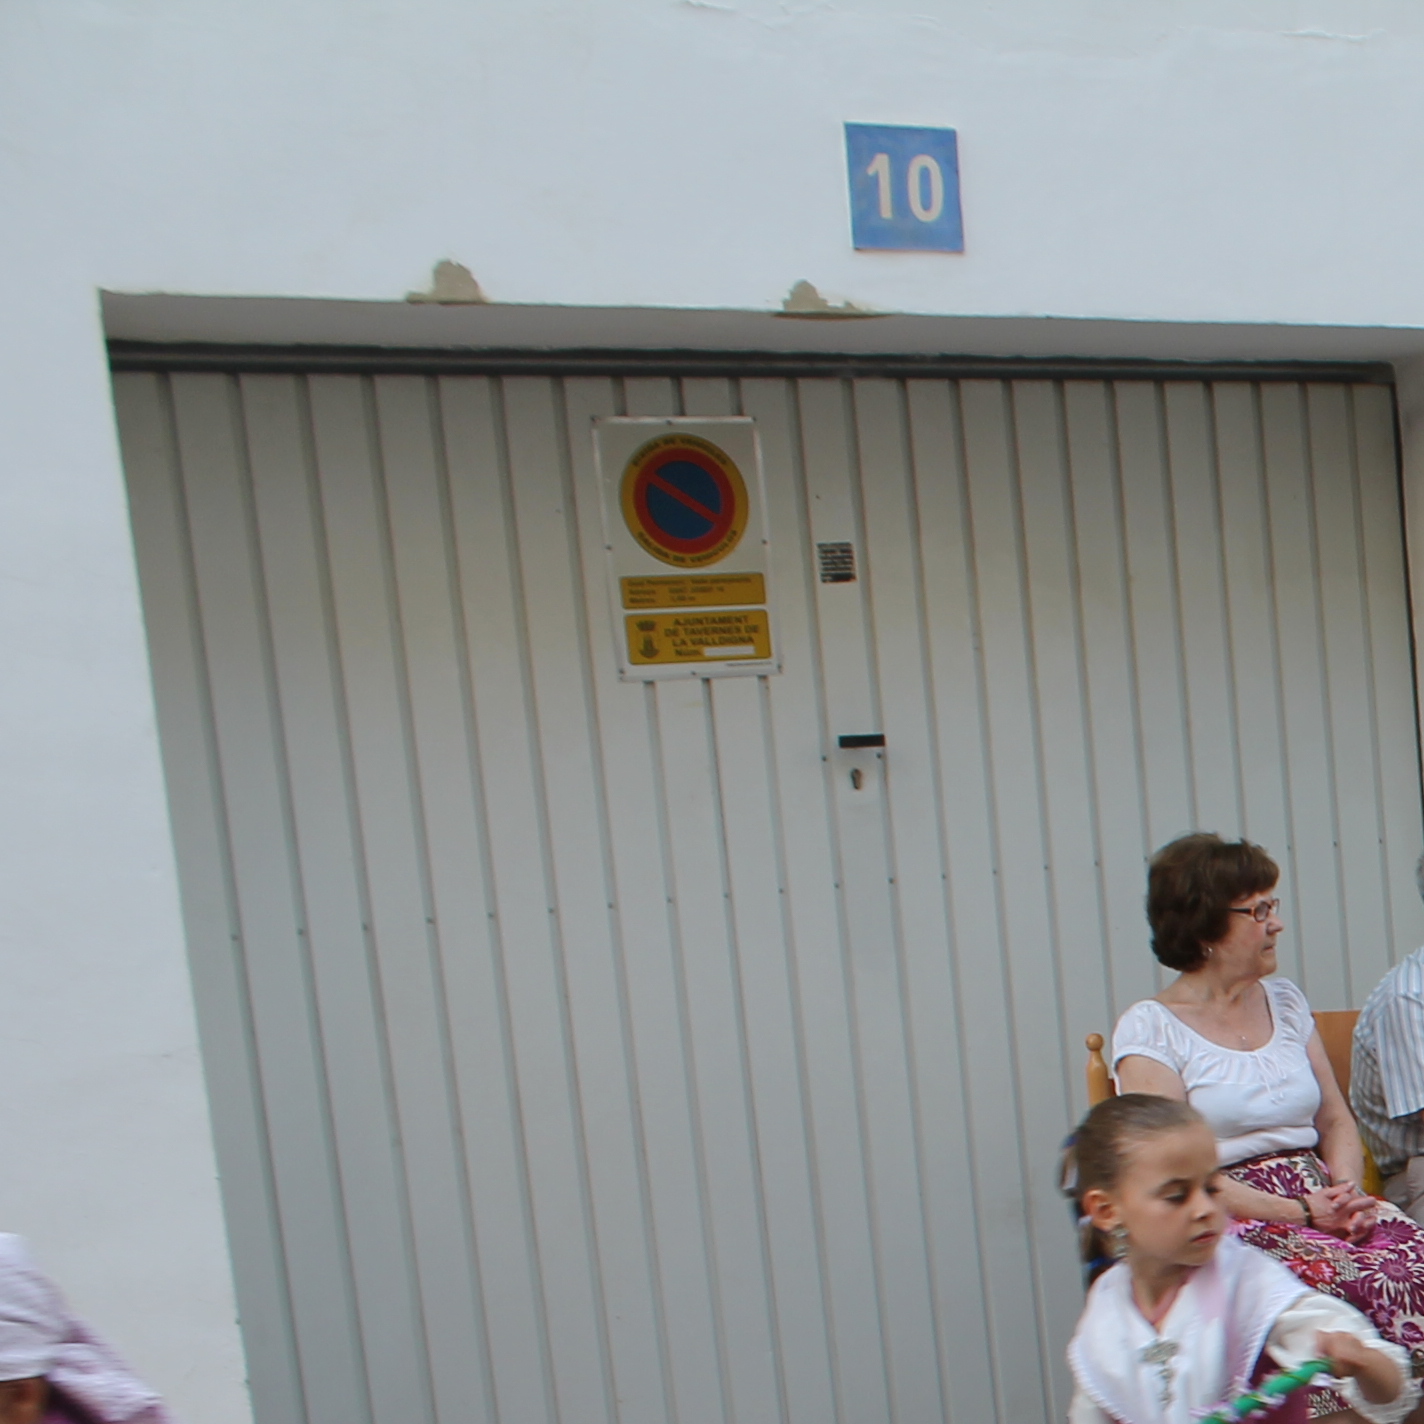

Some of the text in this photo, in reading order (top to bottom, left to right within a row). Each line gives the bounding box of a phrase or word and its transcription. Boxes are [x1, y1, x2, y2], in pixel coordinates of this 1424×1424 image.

[866, 152, 944, 222] 10
[674, 615, 748, 626] AJUNTAMENT
[664, 627, 680, 637] DE
[672, 637, 688, 647] LA
